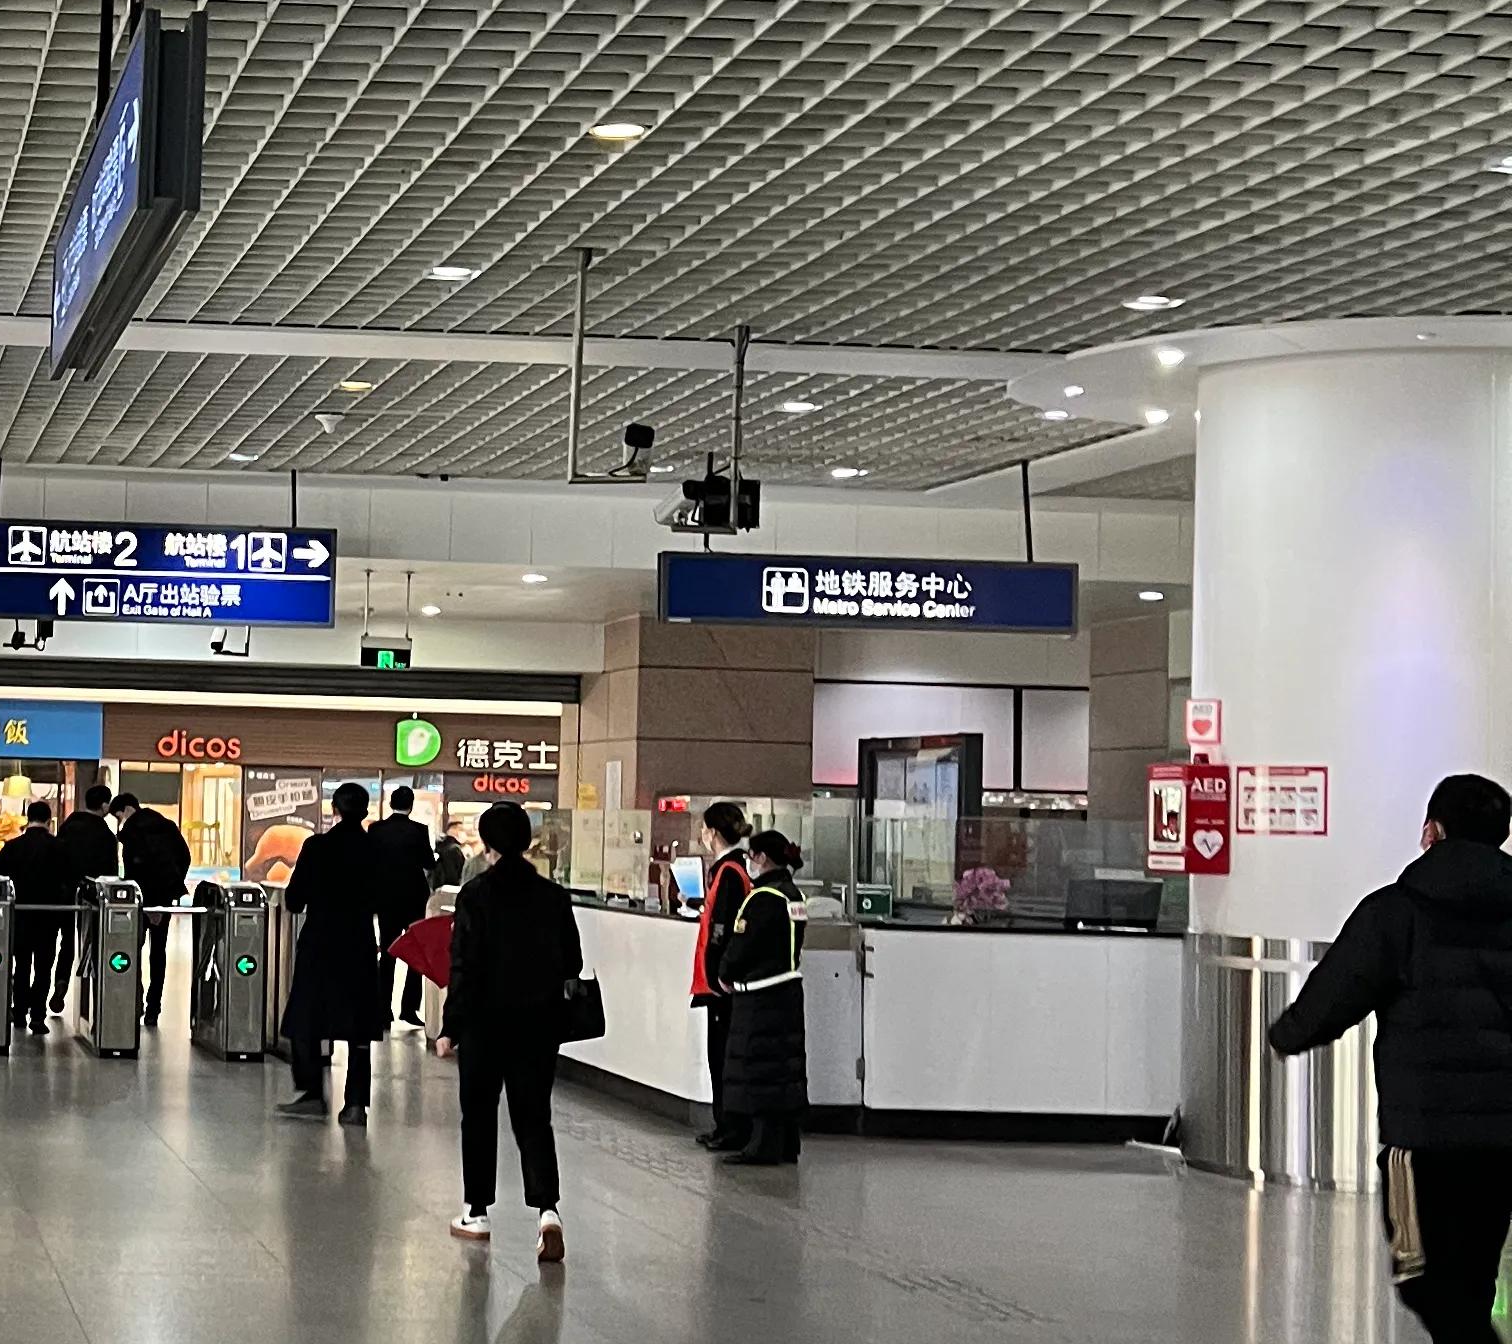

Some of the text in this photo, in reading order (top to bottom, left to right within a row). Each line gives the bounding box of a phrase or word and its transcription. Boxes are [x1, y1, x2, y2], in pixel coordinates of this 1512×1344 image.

[50, 530, 138, 567] 航站楼 2
[164, 532, 246, 570] 航站楼 1
[123, 583, 241, 606] A厅出站验票
[814, 569, 973, 599] 地铁服务中心
[813, 597, 976, 618] Metro Service Center
[157, 729, 241, 759] dicos
[456, 738, 559, 770] 德克士
[472, 772, 531, 794] dicos
[1190, 777, 1227, 794] AED
